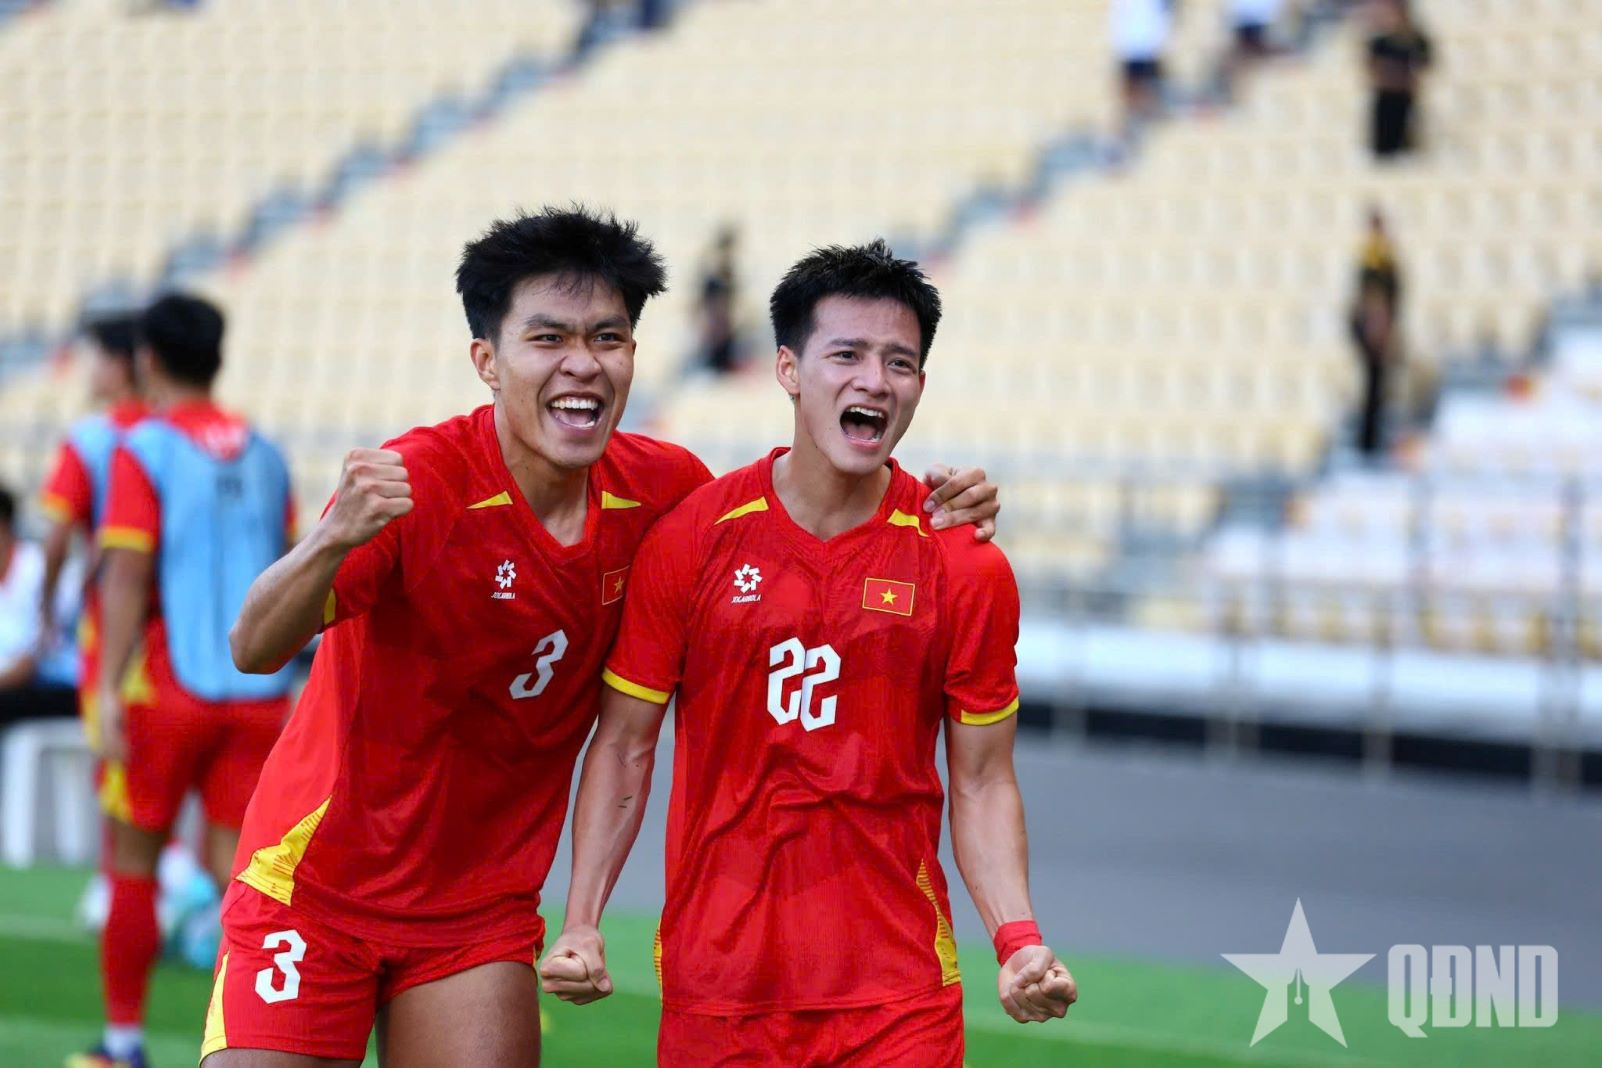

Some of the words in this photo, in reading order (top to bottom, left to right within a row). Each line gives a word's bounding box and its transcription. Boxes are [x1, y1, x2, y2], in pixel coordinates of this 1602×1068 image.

[509, 629, 569, 700] 3
[767, 637, 841, 732] 22
[254, 929, 307, 1004] 3
